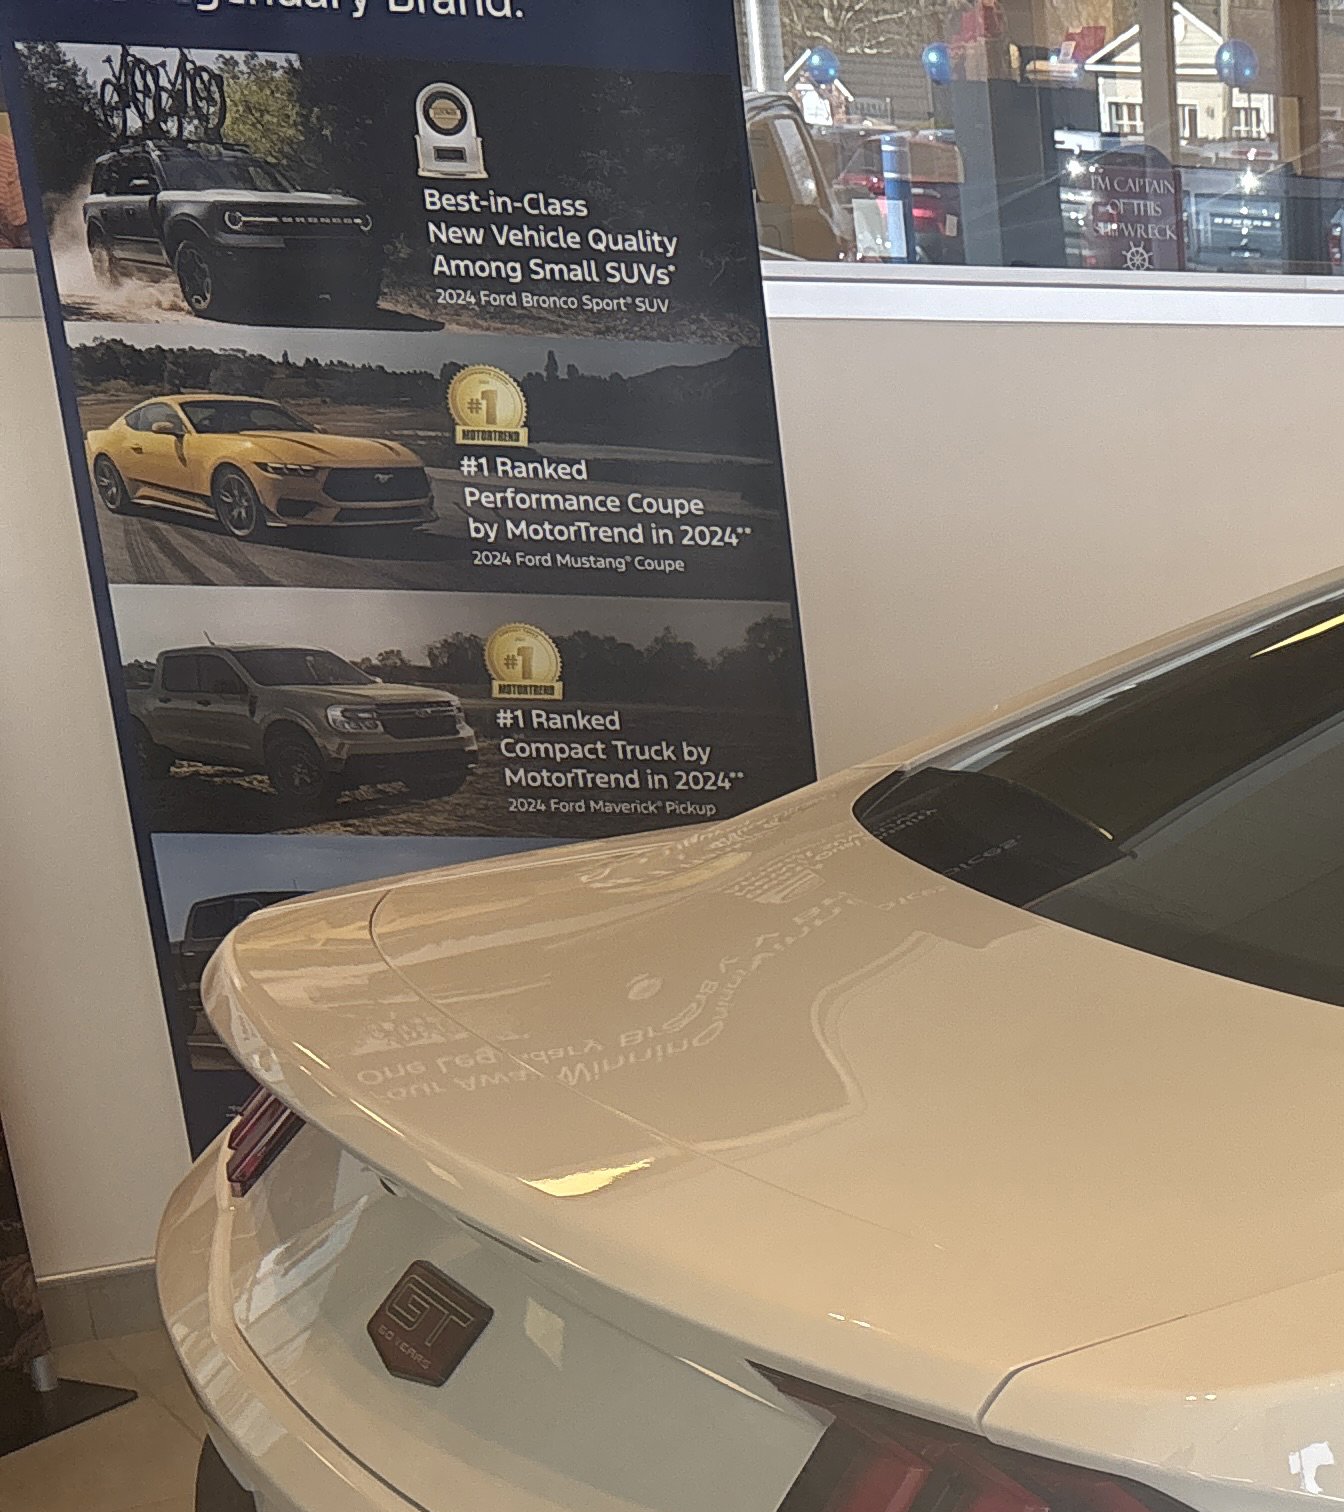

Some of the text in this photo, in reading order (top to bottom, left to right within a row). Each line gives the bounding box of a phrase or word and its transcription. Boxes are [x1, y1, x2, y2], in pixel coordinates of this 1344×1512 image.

[1091, 175, 1175, 193] I'M CAPTAIN
[424, 188, 588, 216] Best-in-Class
[1108, 199, 1162, 216] OF THIS
[427, 221, 677, 257] New Vehicle Quality
[433, 254, 522, 282] Among
[530, 258, 600, 282] Small
[436, 288, 476, 304] 2024
[480, 290, 517, 307] Ford
[522, 292, 578, 309] Bronco
[636, 297, 669, 313] SUV
[460, 456, 587, 480] #1 Ranked
[464, 487, 704, 518] Performance Coupe
[468, 517, 498, 542] by
[506, 519, 643, 544] MotorTrend
[651, 524, 673, 545] in
[472, 550, 512, 566] 2024
[515, 551, 551, 567] Ford
[634, 556, 685, 573] Coupe
[496, 708, 620, 731] #1 Ranked
[500, 738, 711, 765] Compact Truck by
[504, 767, 640, 789] MotorTrend
[646, 769, 668, 789] in
[508, 798, 546, 812] 2024
[550, 799, 586, 813] Ford
[666, 801, 717, 817] Pickup
[386, 1274, 475, 1347] GT
